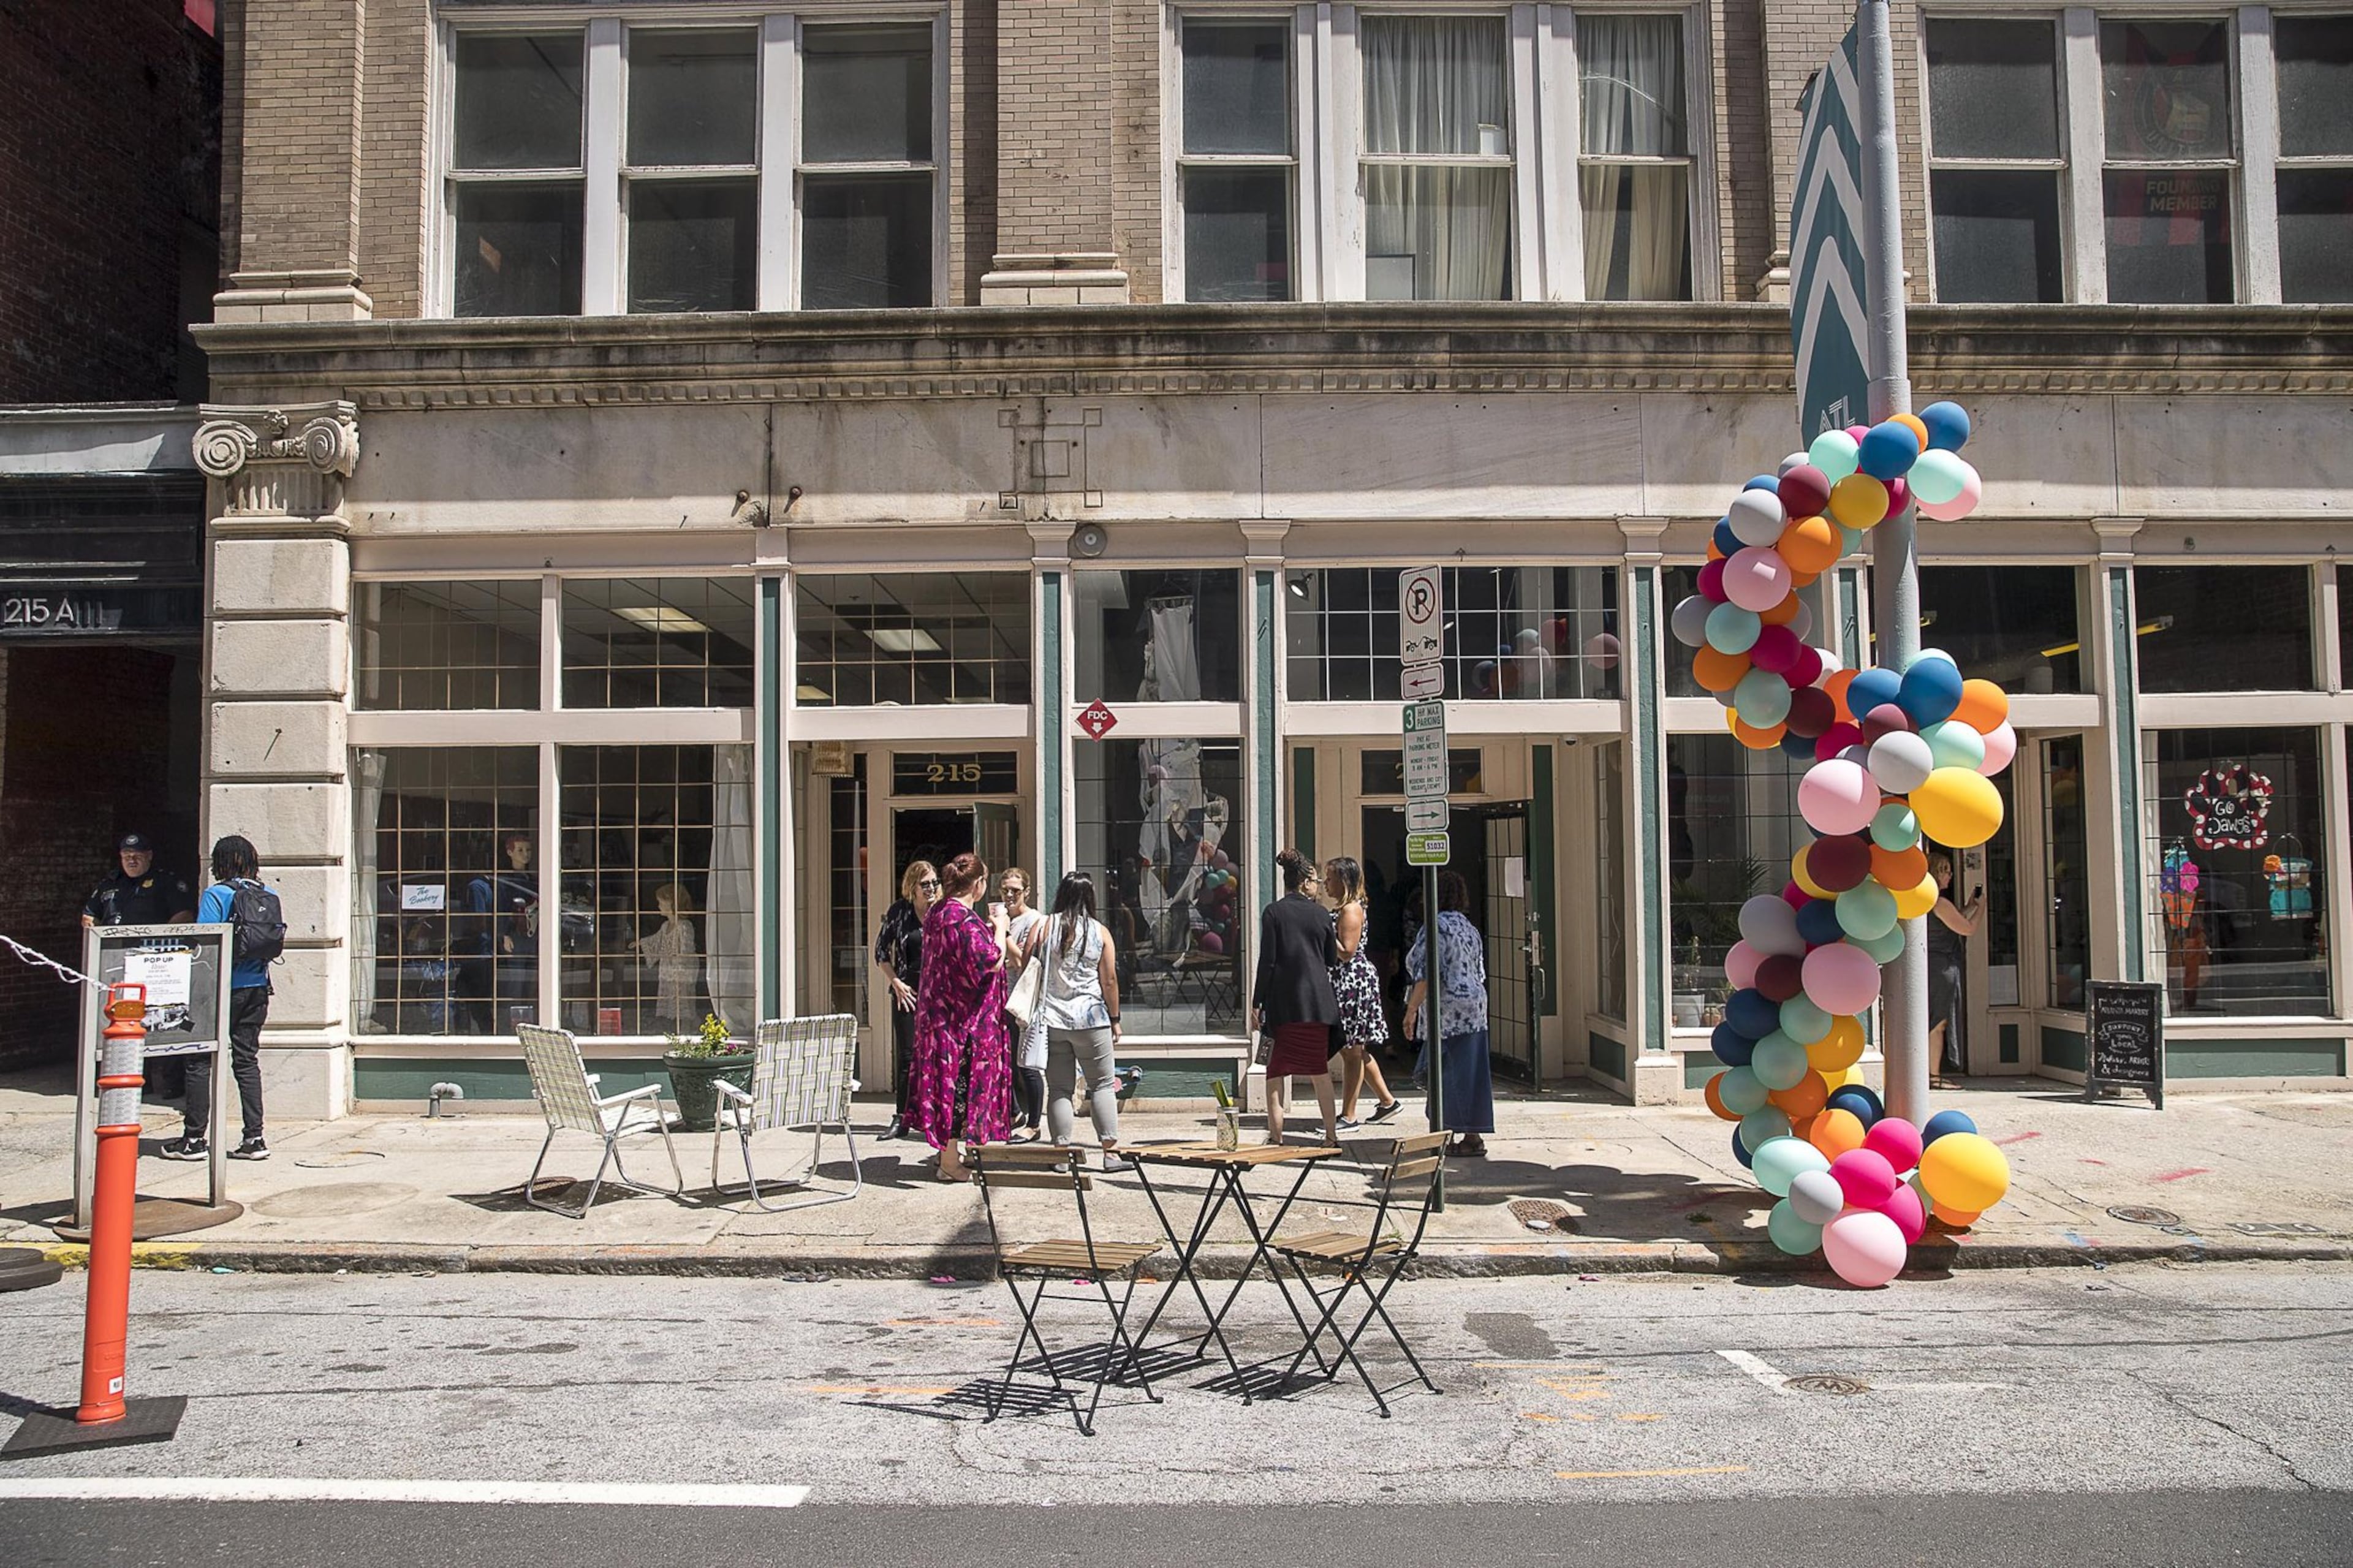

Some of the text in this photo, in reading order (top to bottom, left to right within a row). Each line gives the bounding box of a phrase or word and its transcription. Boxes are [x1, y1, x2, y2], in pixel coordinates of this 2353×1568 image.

[2150, 195, 2218, 212] MEMBER
[4, 597, 75, 623] 215 A
[1087, 710, 1108, 721] FDC
[1406, 705, 1439, 729] 3 HR MAX
[1417, 716, 1441, 728] PARKING
[1409, 743, 1425, 752] PARKING
[926, 763, 982, 783] 215
[417, 887, 429, 895] The
[2111, 1039, 2138, 1049] LOCAL
[2101, 1064, 2111, 1075] &
